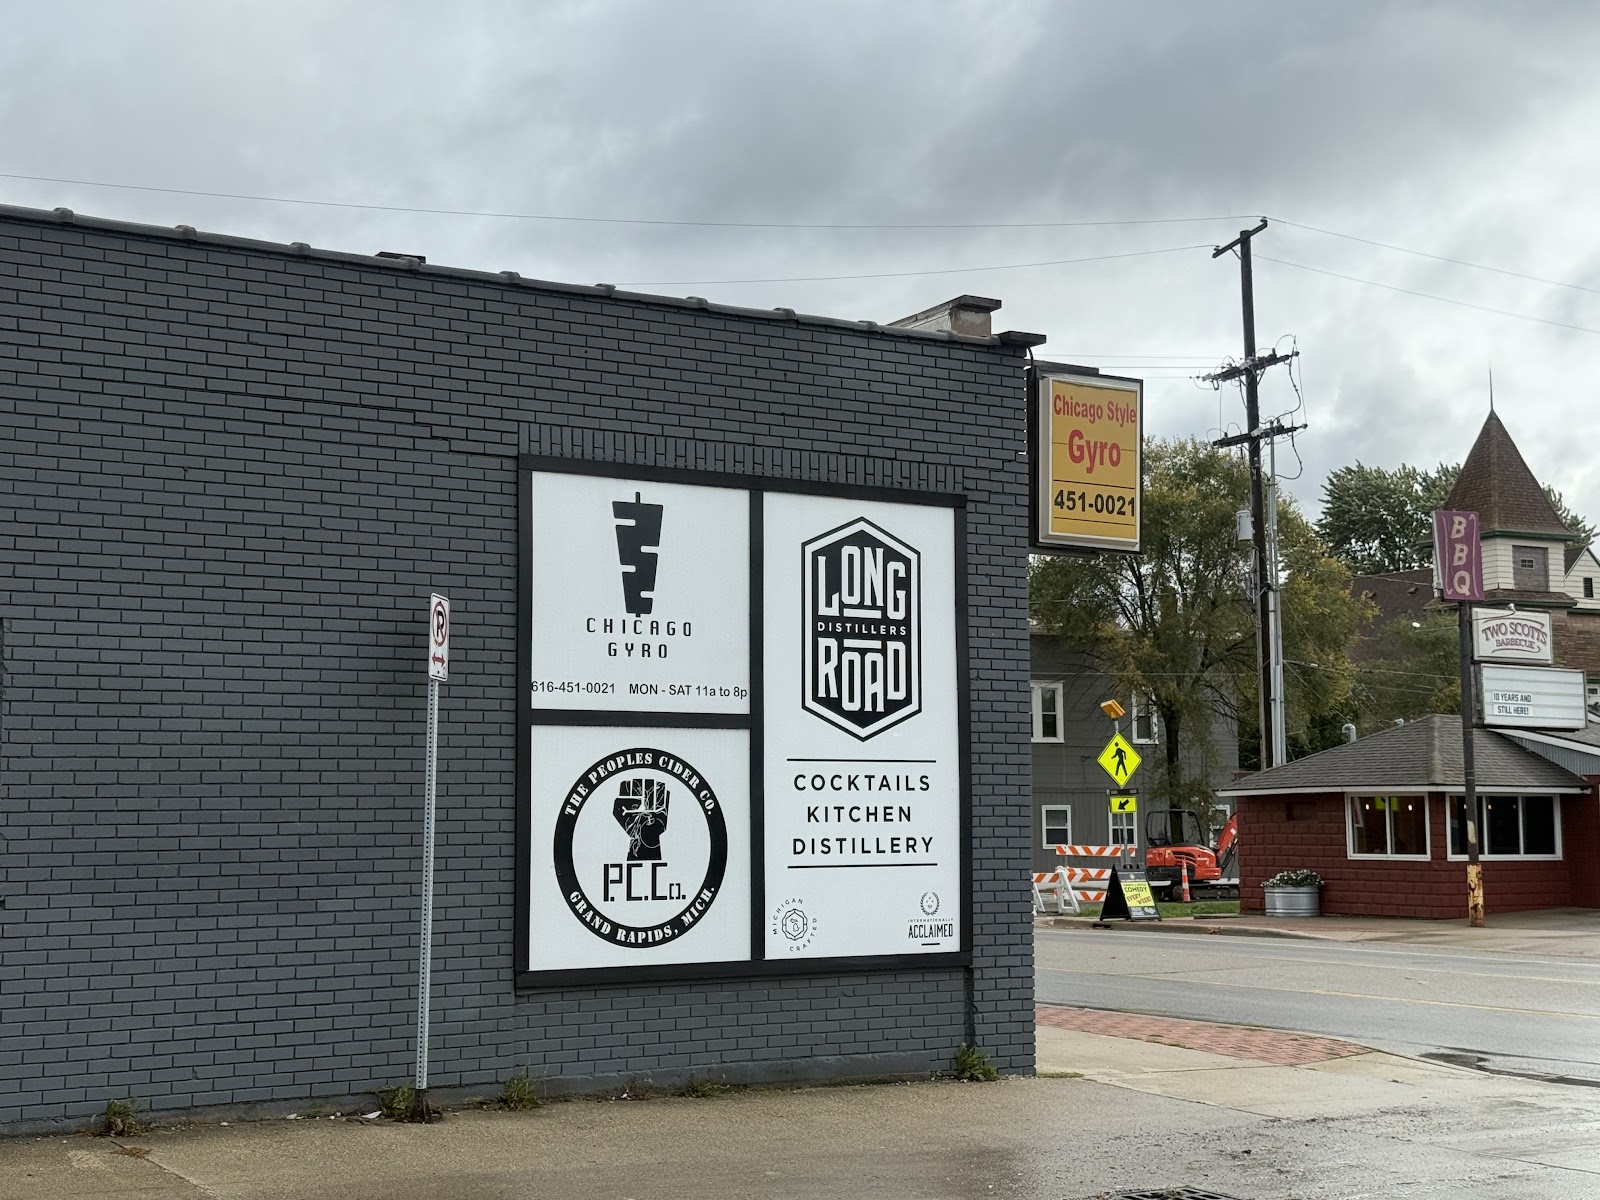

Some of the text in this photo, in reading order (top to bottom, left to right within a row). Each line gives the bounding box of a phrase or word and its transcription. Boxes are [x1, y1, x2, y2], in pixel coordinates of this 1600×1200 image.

[1053, 394, 1136, 427] Chicago Style
[1068, 429, 1121, 474] Gyro
[1054, 489, 1135, 517] 451-0021
[1451, 516, 1471, 596] BBQ
[817, 545, 907, 621] LONG
[586, 617, 692, 637] CHICAGO
[817, 621, 907, 636] DISTILLERS
[1482, 622, 1548, 646] TWO SCOTTS
[607, 642, 668, 659] GYRO
[1495, 638, 1535, 649] BARBECUE
[817, 637, 908, 712] ROAD
[531, 681, 615, 694] 616-451-0021
[629, 683, 658, 695] MON
[668, 684, 692, 696] SAT
[695, 685, 716, 697] 11a
[719, 686, 730, 697] to
[733, 686, 748, 700] 8p
[1493, 692, 1532, 703] 10 YEARS AND
[1497, 705, 1529, 715] STILL HERE!
[564, 752, 718, 817] THE PEOPLES CIDER CO.
[793, 774, 931, 792] COCKTAILS
[807, 806, 911, 823] KITCHEN
[792, 836, 934, 855] DISTILLERY
[569, 886, 716, 944] GRAND RAPIDS, MICH.
[772, 898, 804, 936] MICHIGAN
[789, 917, 818, 952] CRAFTED
[908, 923, 954, 939] ACCLAIMED
